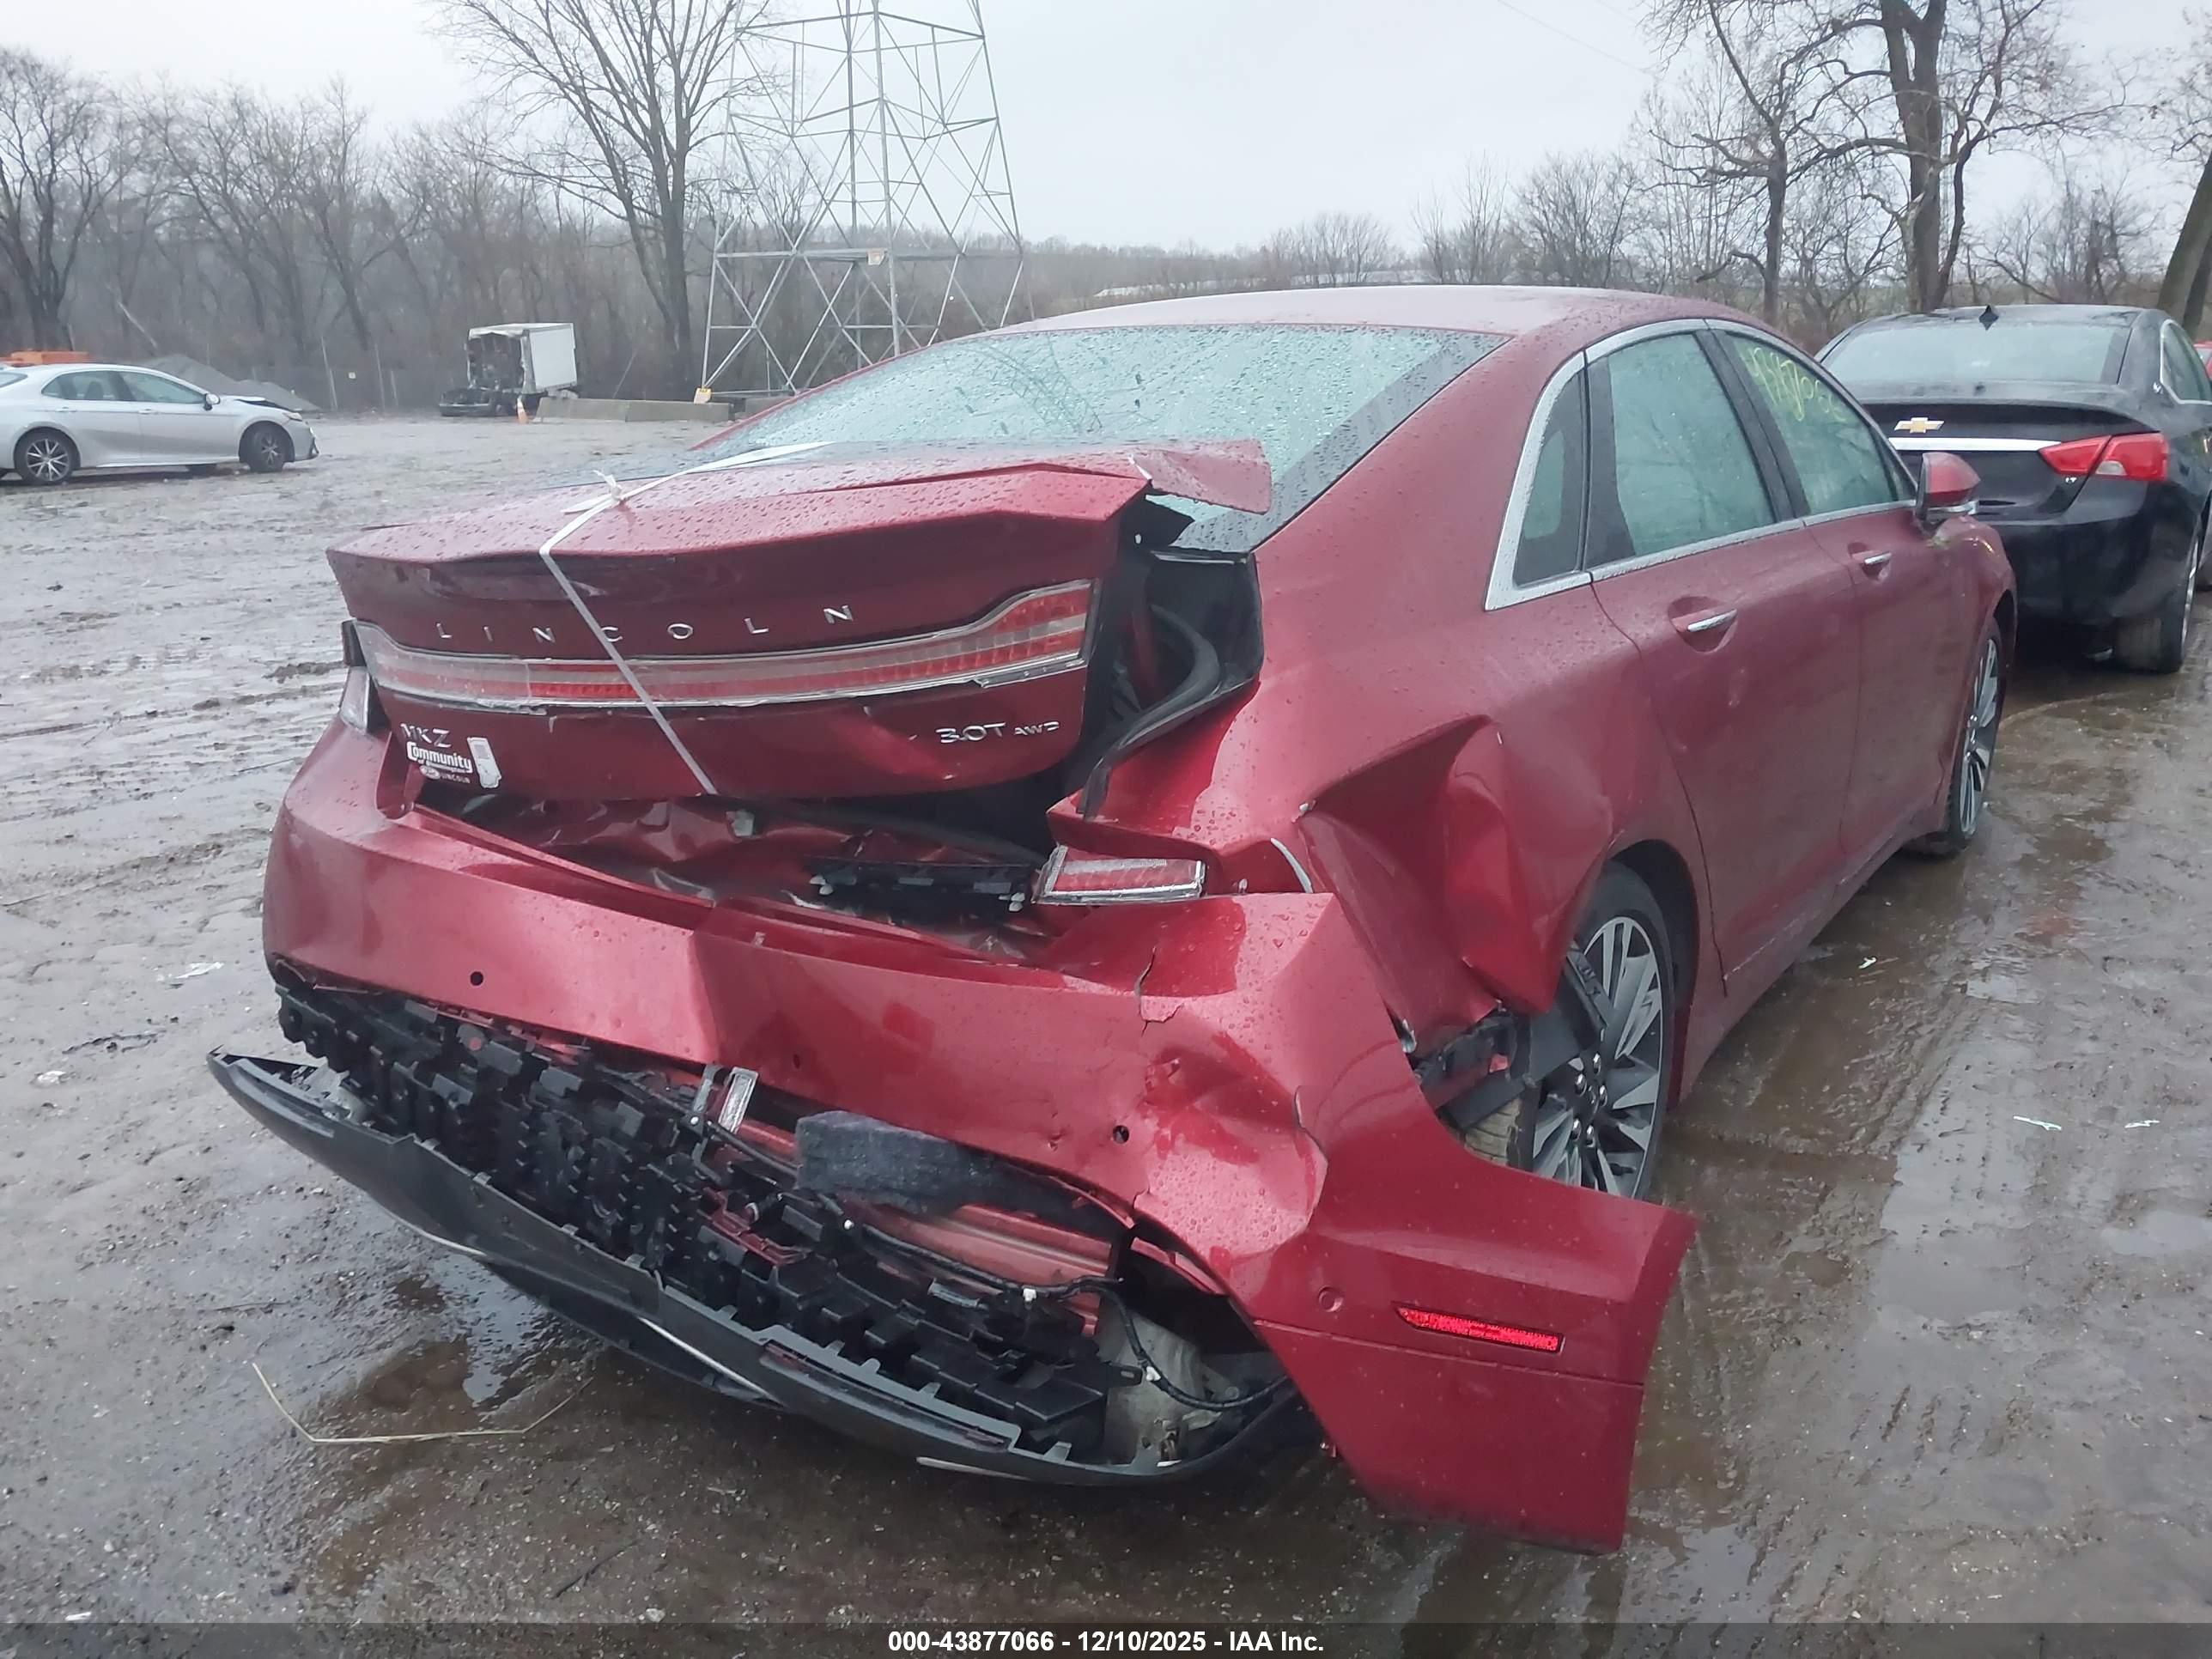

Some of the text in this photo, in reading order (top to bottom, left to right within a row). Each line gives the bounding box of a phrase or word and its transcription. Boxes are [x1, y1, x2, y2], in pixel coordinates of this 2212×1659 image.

[436, 604, 854, 644] LINCOLN
[400, 722, 452, 748] MKZ
[406, 741, 473, 774] Community
